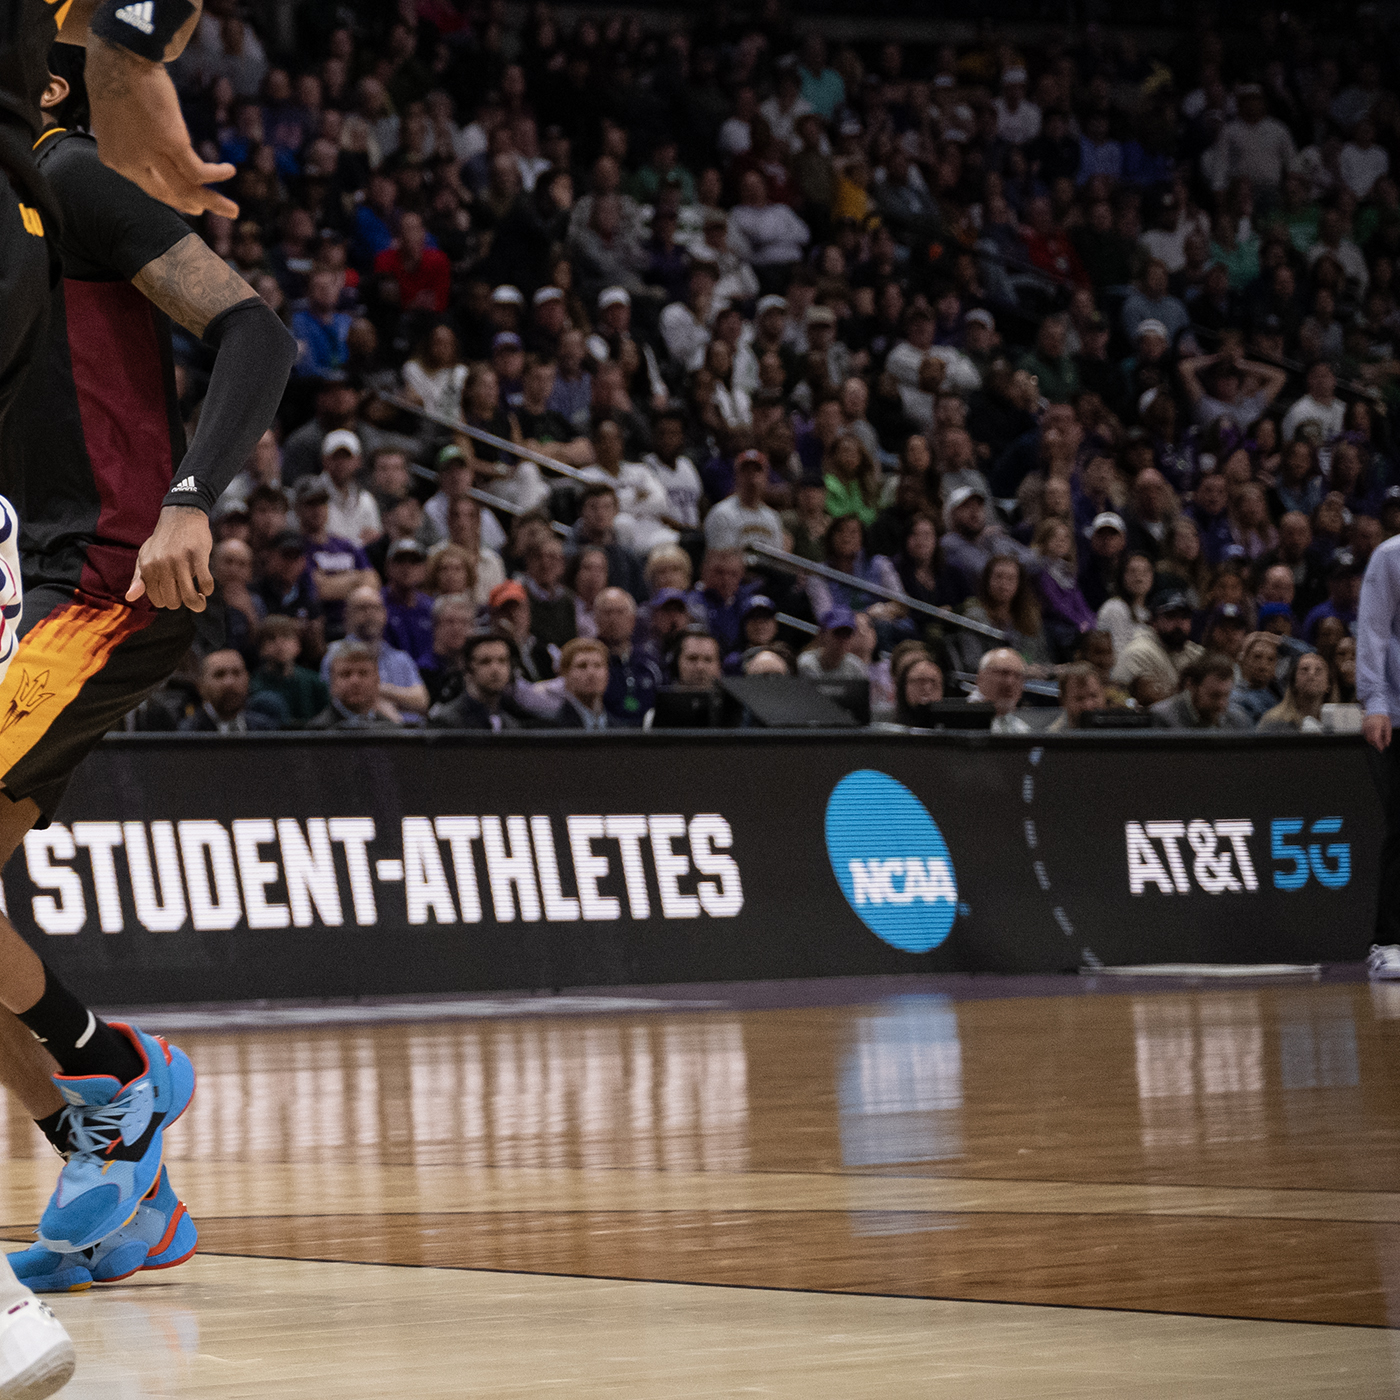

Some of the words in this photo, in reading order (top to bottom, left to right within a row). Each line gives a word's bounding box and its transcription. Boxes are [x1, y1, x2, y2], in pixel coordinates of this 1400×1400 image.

[24, 814, 745, 935] STUDENT-ATHLETES
[848, 856, 958, 906] NCAA
[1125, 818, 1258, 895] AT&T
[1270, 816, 1351, 891] 5G
